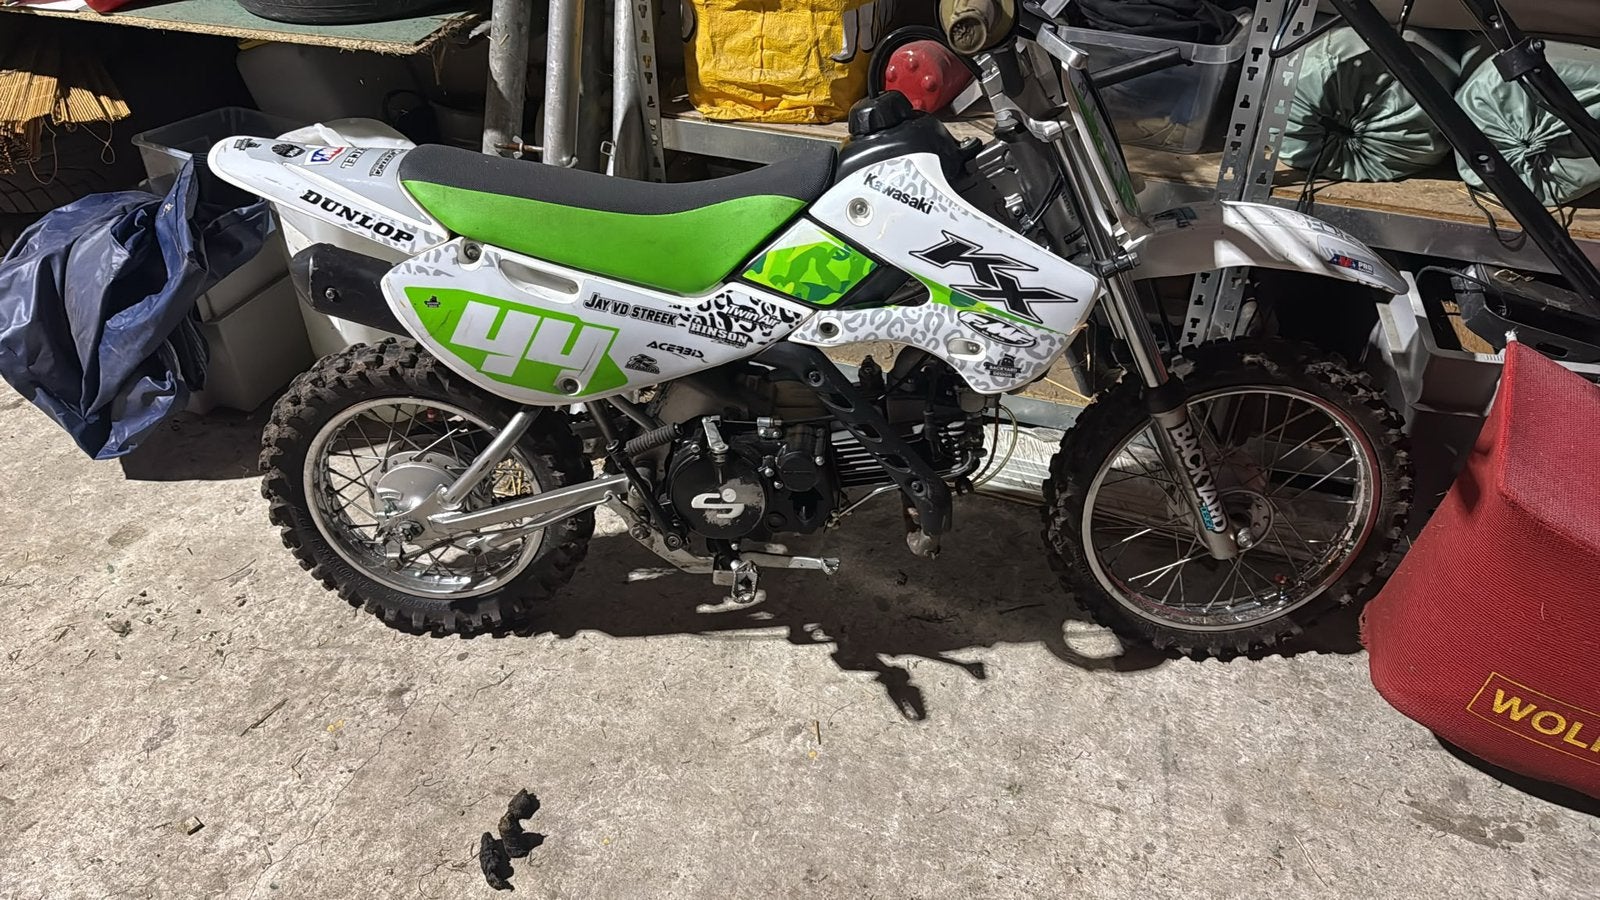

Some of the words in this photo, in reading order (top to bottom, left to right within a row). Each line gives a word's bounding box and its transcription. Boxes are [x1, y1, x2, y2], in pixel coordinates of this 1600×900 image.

[863, 173, 934, 215] Kawasaki
[299, 189, 415, 243] DUNLOP
[909, 230, 1078, 323] KX
[584, 293, 611, 312] JAY
[612, 301, 630, 317] VD
[631, 305, 678, 327] STREEK
[727, 303, 759, 322] Twin
[758, 312, 780, 328] Air
[959, 311, 1037, 344] FMF
[690, 322, 749, 344] HINSON
[1168, 421, 1228, 533] BACKYARD
